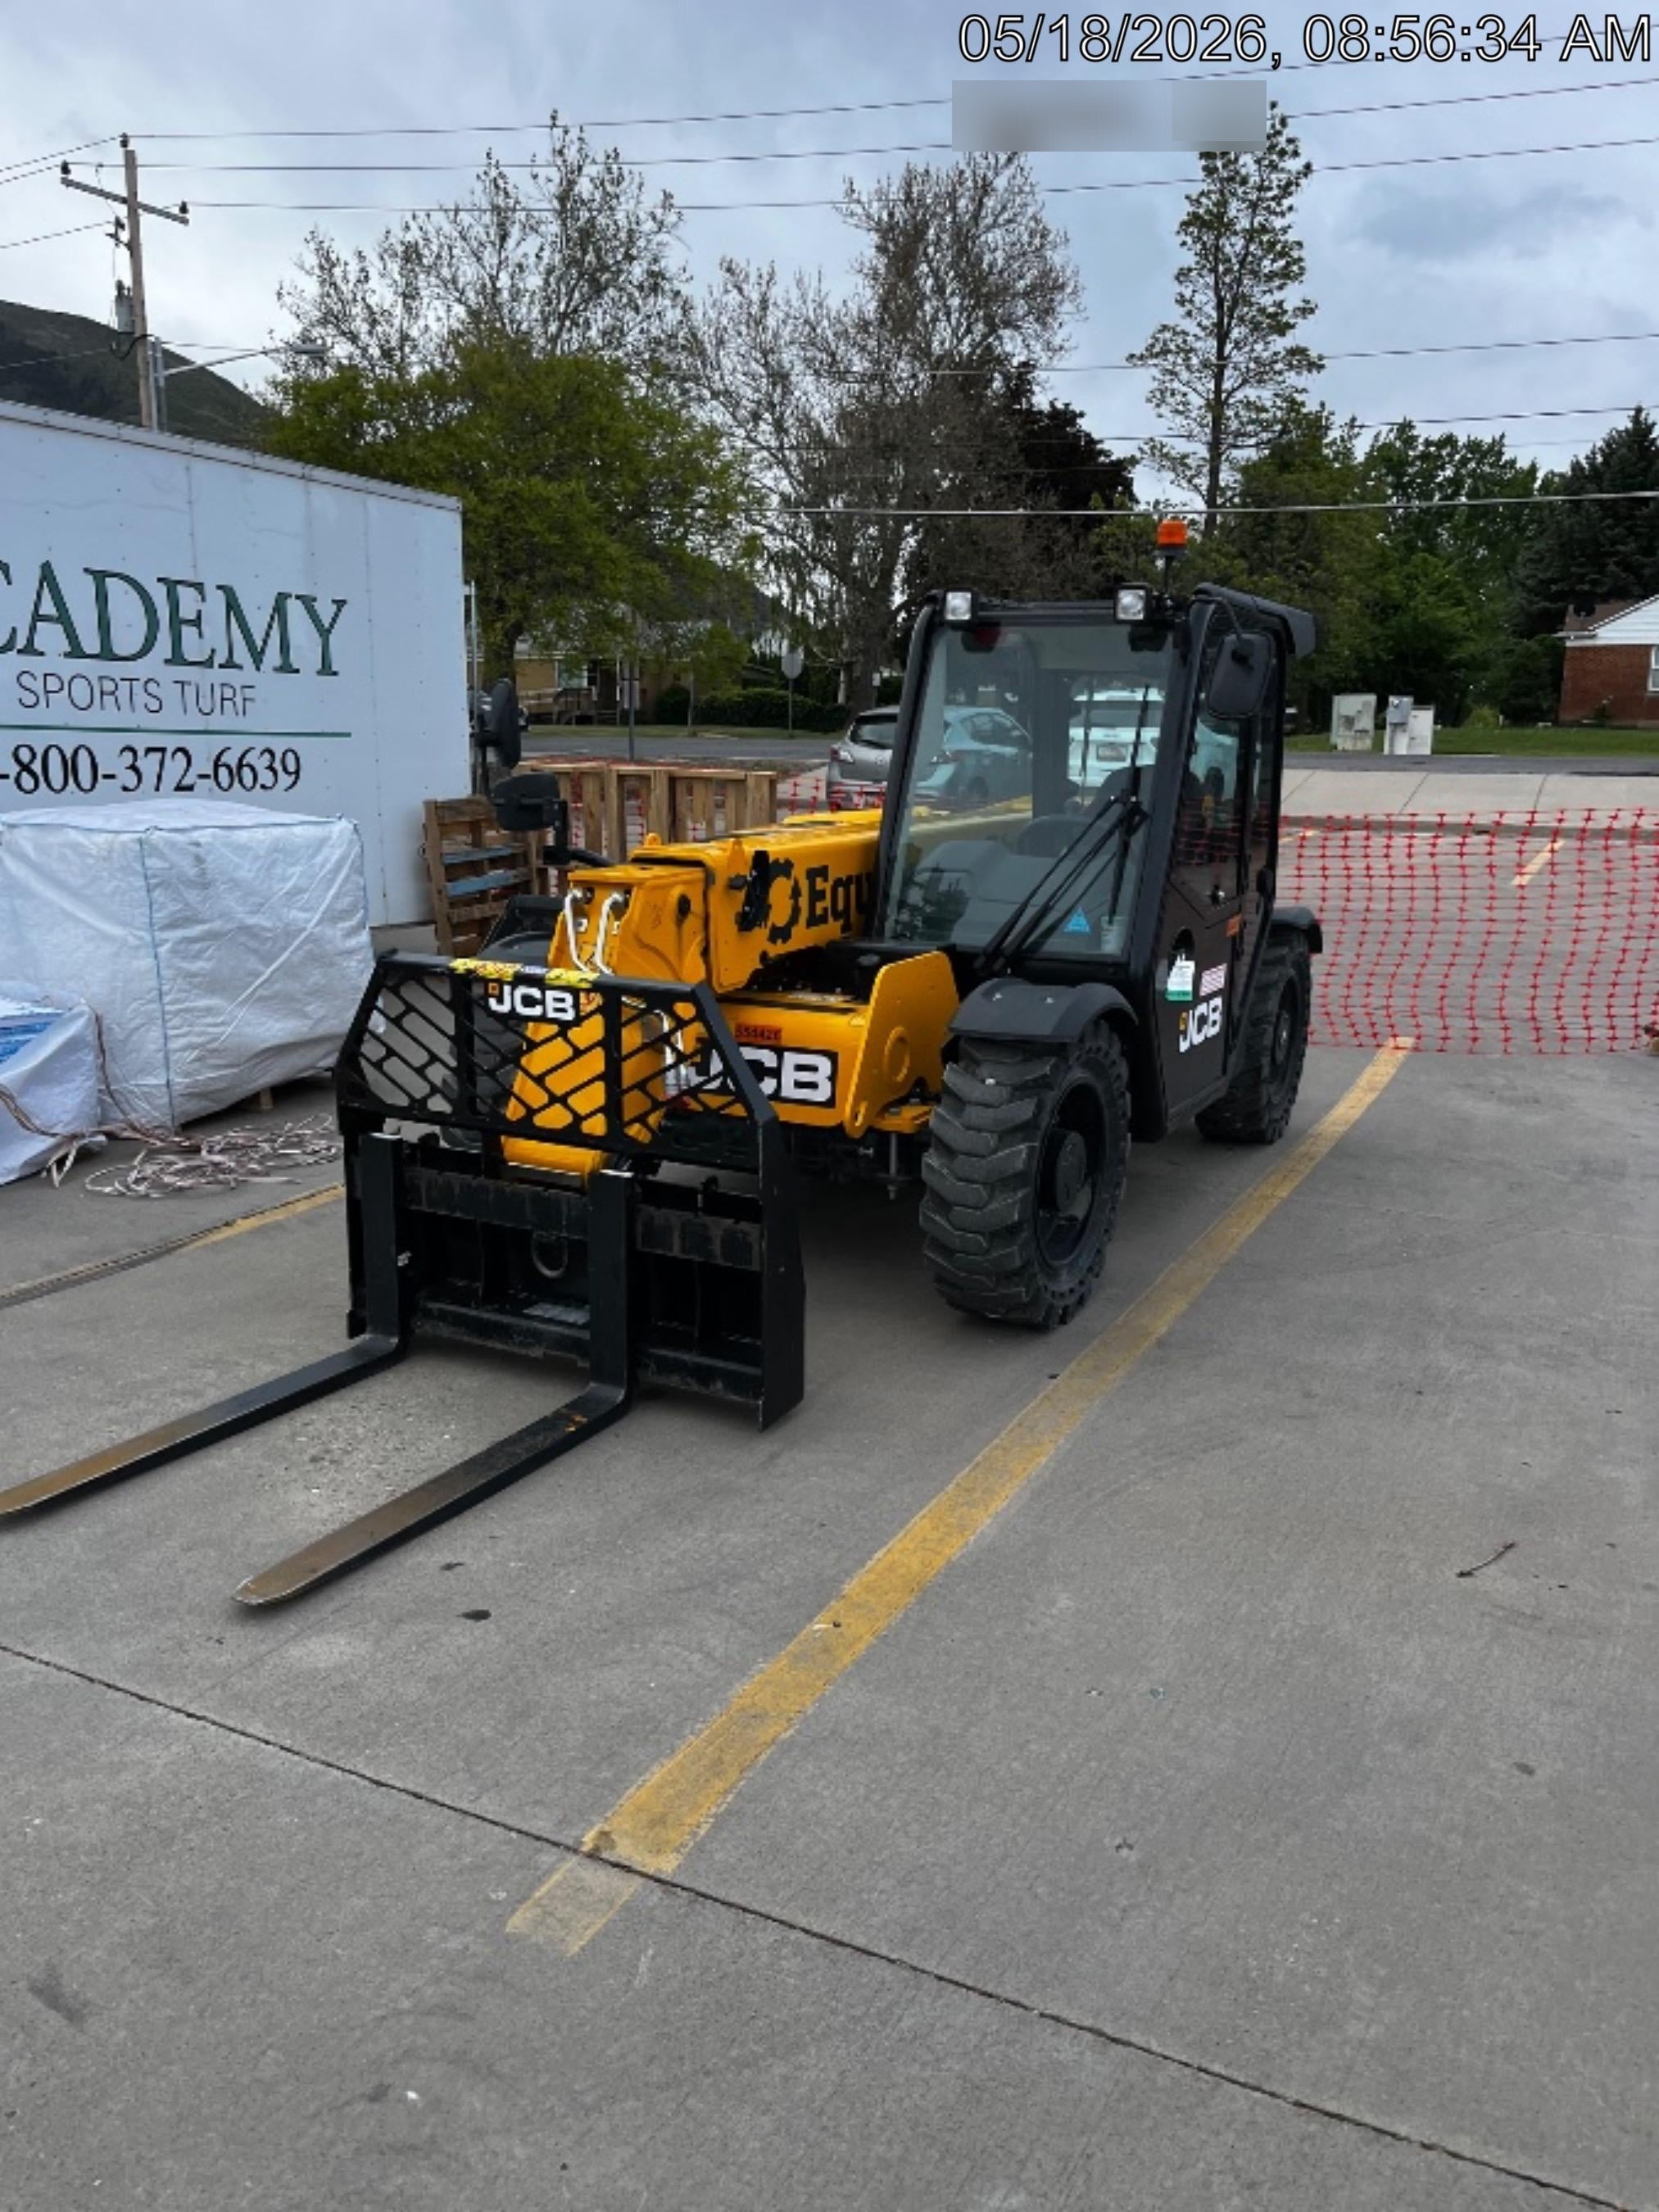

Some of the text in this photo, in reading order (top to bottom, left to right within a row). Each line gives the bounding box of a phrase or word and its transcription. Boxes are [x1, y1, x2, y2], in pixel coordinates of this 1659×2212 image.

[16, 670, 256, 717] SPORTS TURF
[488, 985, 575, 1021] JCB
[1179, 995, 1222, 1053] JCB
